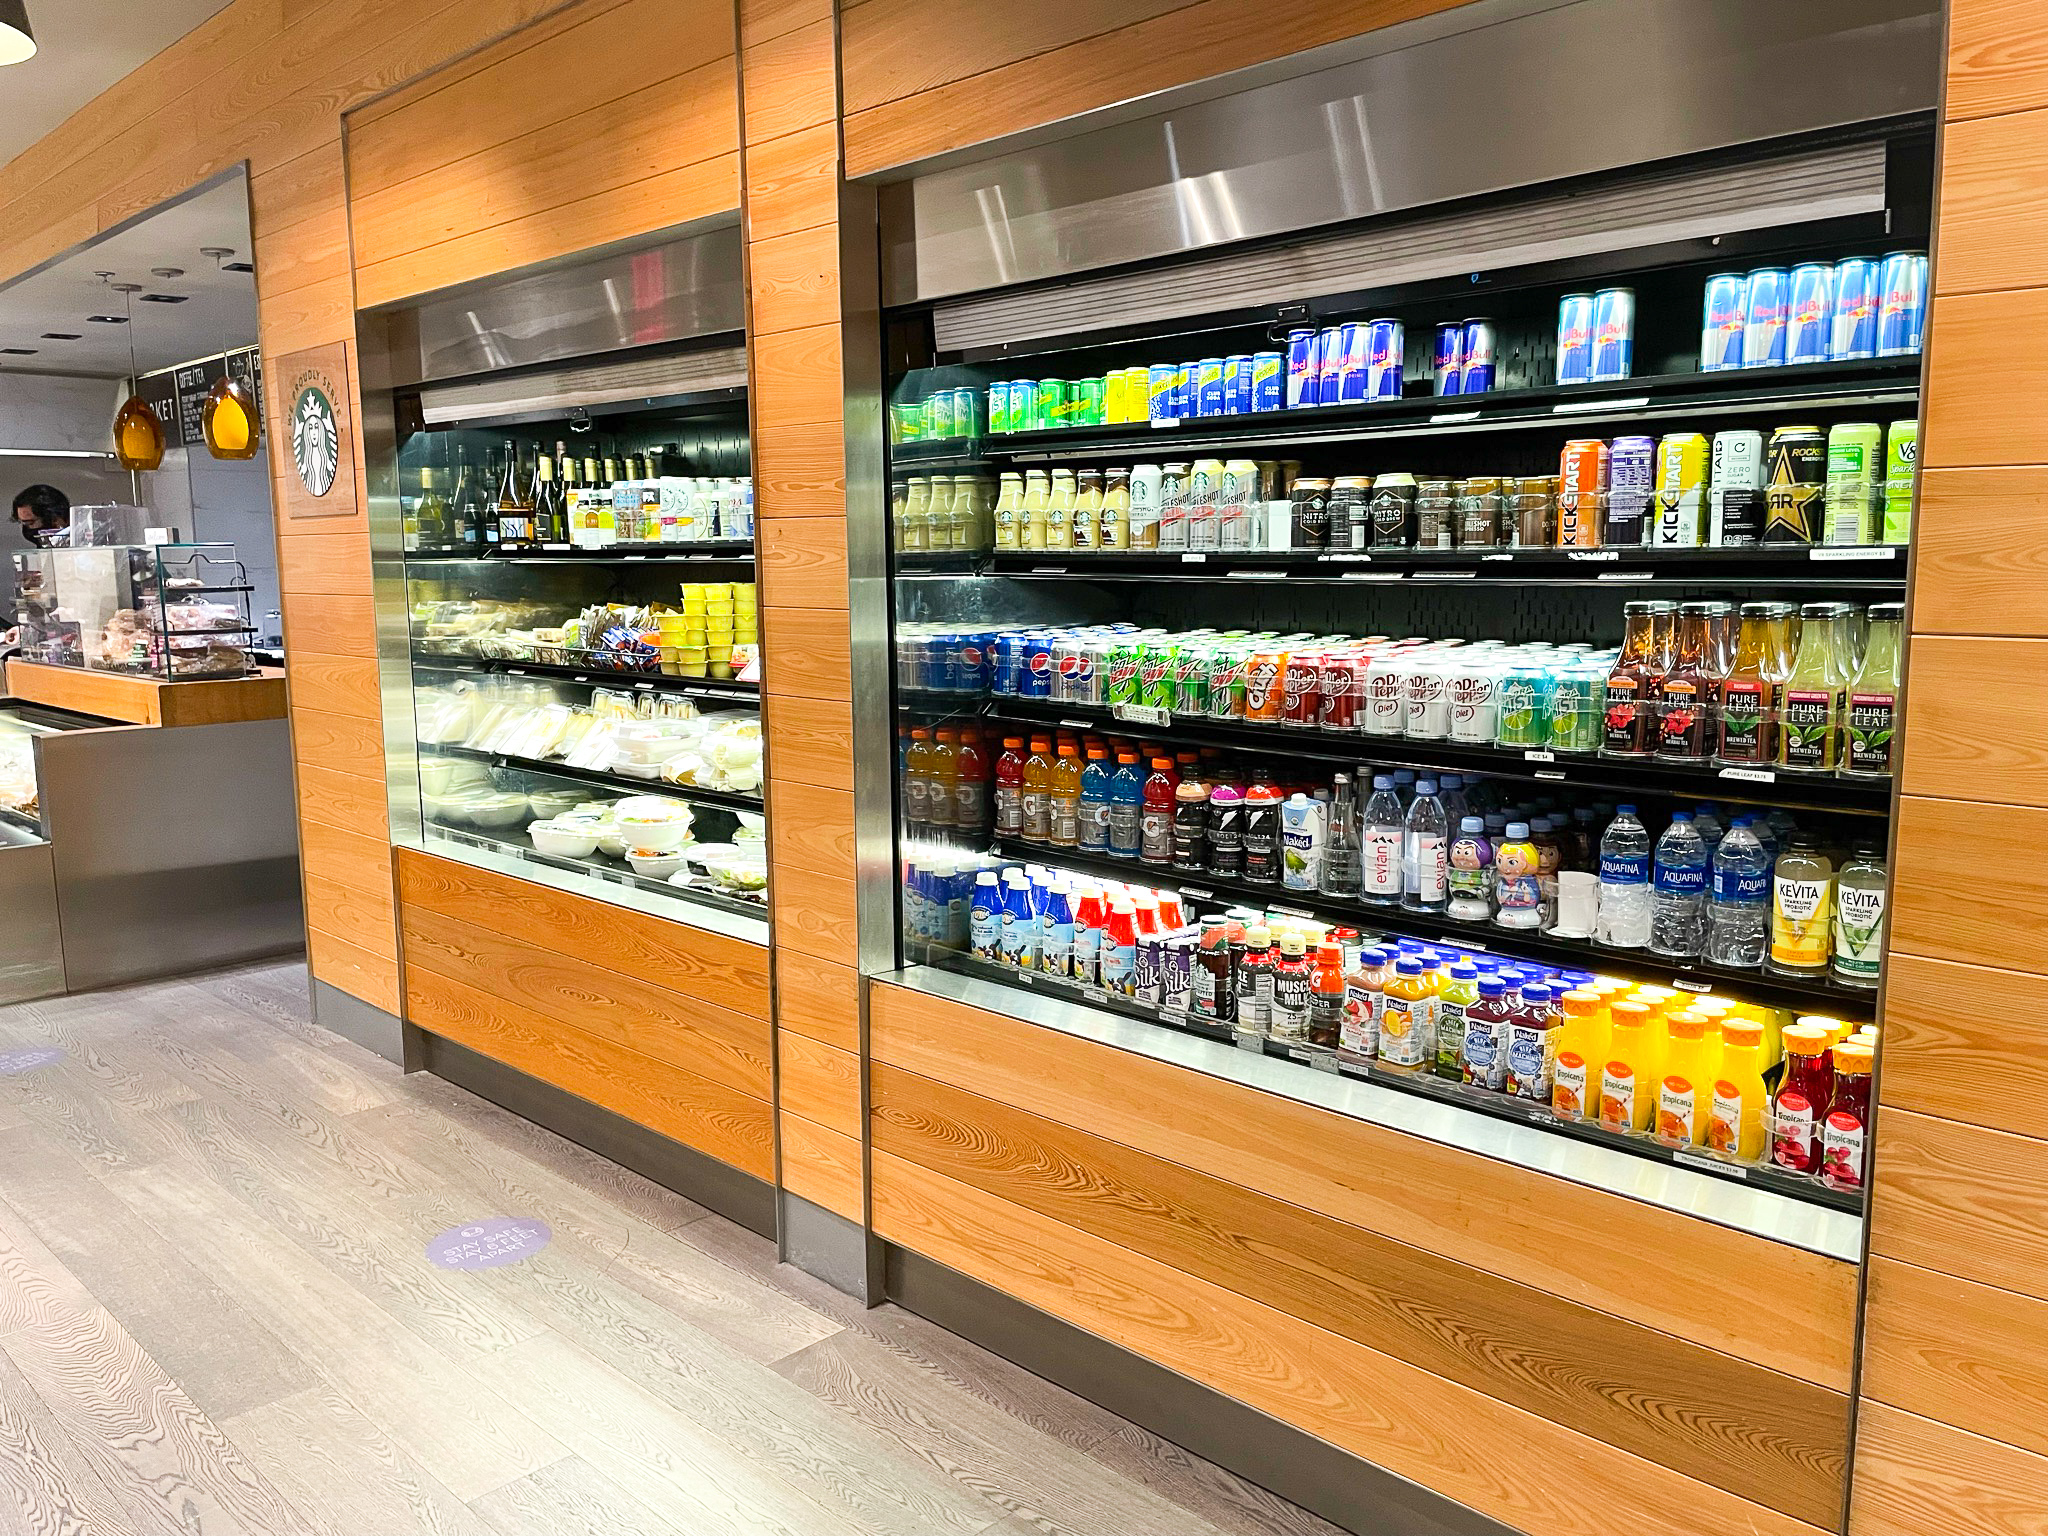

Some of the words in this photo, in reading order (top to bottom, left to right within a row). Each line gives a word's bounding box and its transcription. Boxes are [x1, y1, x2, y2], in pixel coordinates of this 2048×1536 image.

[1892, 290, 1917, 303] Bull
[1606, 323, 1629, 335] Bull
[292, 369, 321, 401] PROUDLY
[323, 376, 342, 418] SERVE
[149, 399, 175, 422] KET
[1386, 673, 1402, 686] Dr
[1414, 675, 1430, 688] Dr
[1463, 678, 1479, 691] Dr
[1611, 688, 1632, 696] PURE
[1668, 692, 1691, 701] PURE
[1729, 694, 1758, 704] PURE
[1378, 703, 1393, 714] Diet
[1455, 708, 1469, 717] Diet
[1792, 704, 1824, 714] PURE
[1855, 707, 1889, 717] PURE
[1791, 713, 1824, 723] LEAF
[1855, 717, 1888, 727] LEAF
[1284, 833, 1310, 849] Naked
[1377, 845, 1388, 884] evian
[1436, 851, 1445, 890] evian
[1601, 860, 1639, 875] AQUAFINA
[1663, 870, 1703, 883] AQUAFINA
[1784, 898, 1812, 906] SPARKLING
[1845, 906, 1873, 914] SPARKLING
[1135, 965, 1161, 988] Silk
[1165, 969, 1191, 994] Silk
[1349, 990, 1369, 1001] Naked
[1387, 1000, 1407, 1012] Naked
[1444, 1004, 1462, 1015] Naked
[1470, 1023, 1490, 1034] Naked
[1515, 1030, 1537, 1041] Naked
[1557, 1069, 1584, 1083] Tropicana
[1604, 1079, 1633, 1093] Tropicana
[1662, 1093, 1692, 1108] Tropicana
[1827, 1132, 1860, 1148] Tropicana
[444, 1240, 480, 1257] STAY
[484, 1226, 525, 1243] SAFE
[446, 1247, 482, 1264] STAY
[500, 1228, 539, 1245] FEET
[480, 1241, 526, 1263] APART
